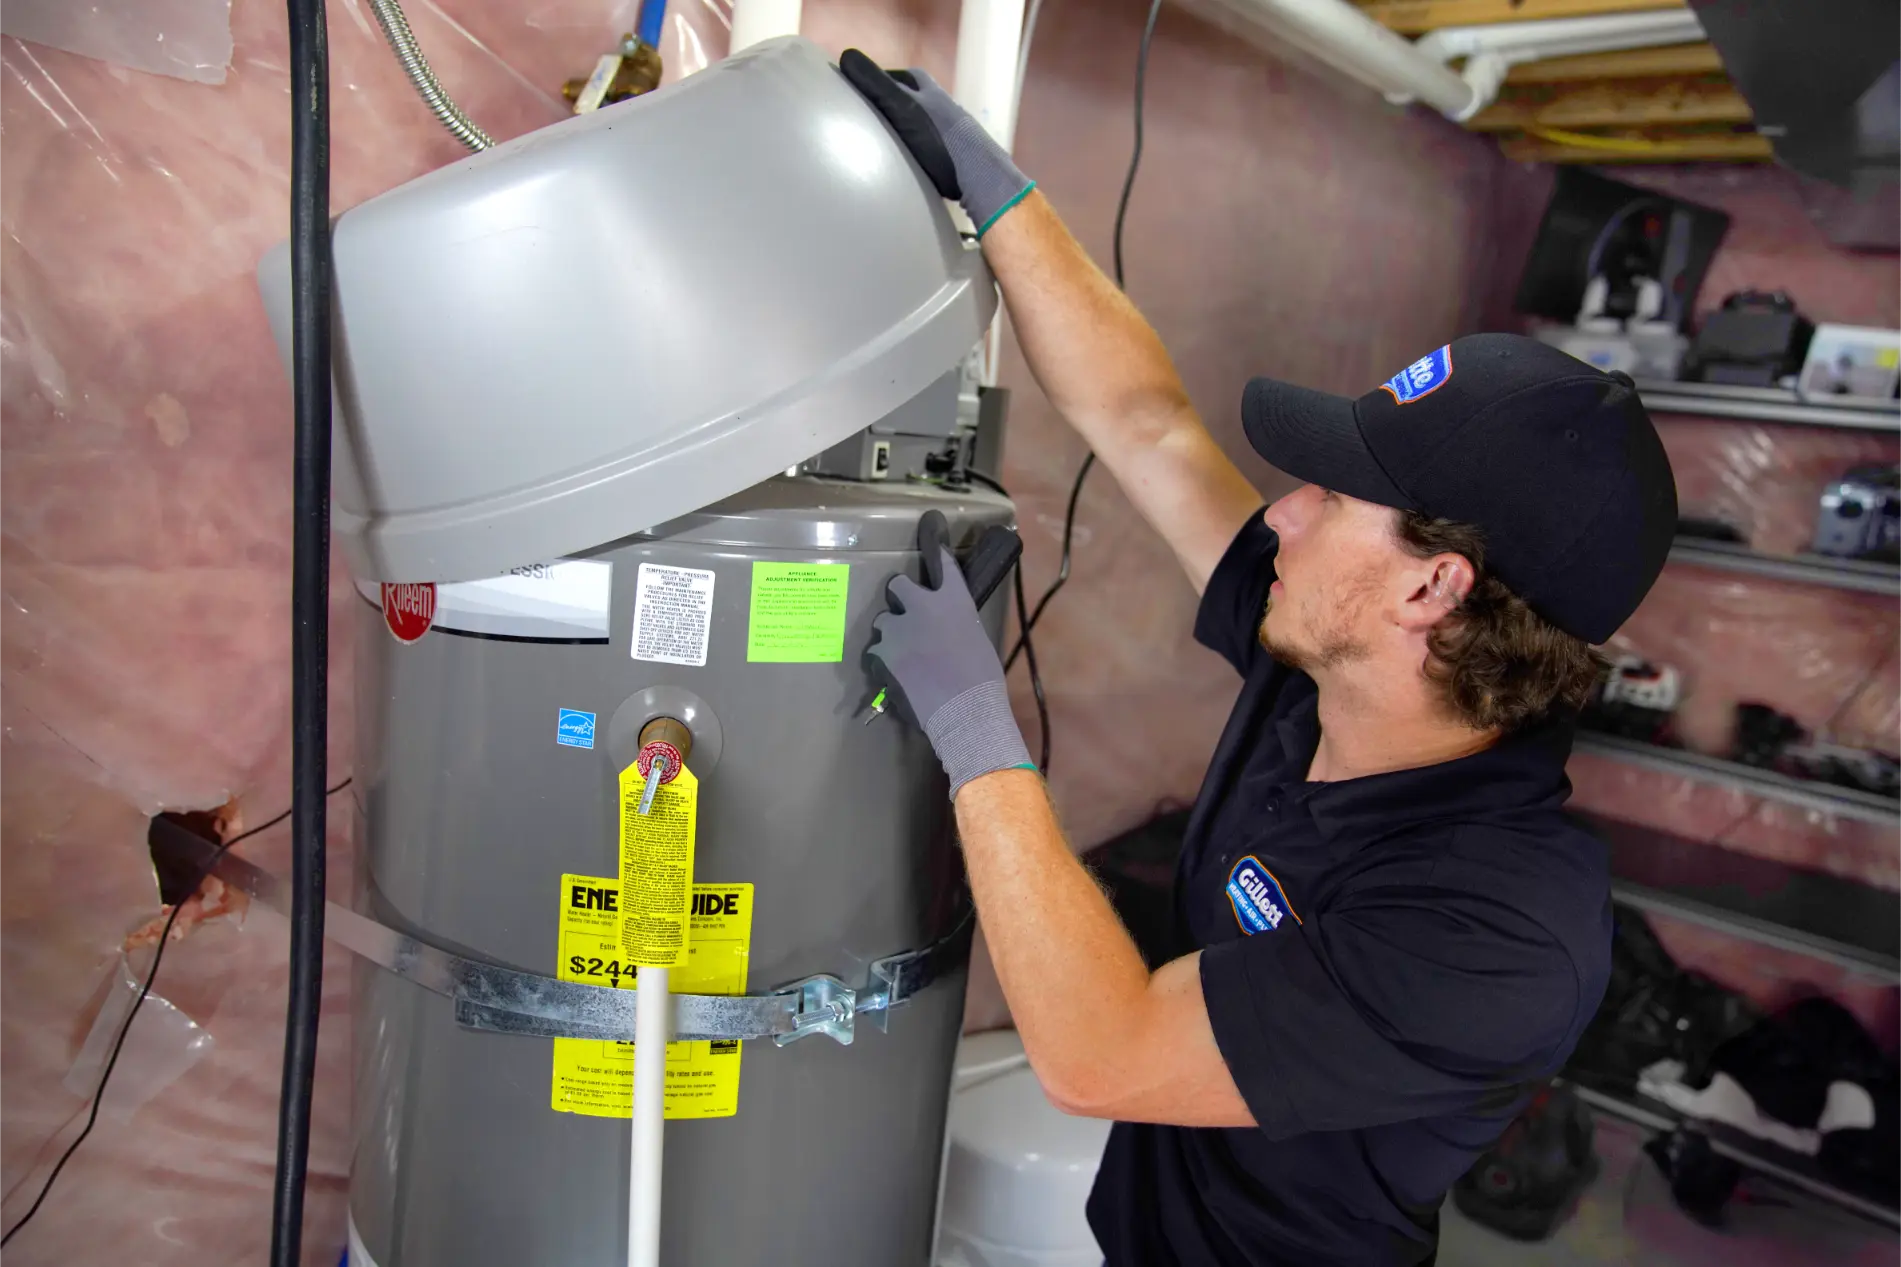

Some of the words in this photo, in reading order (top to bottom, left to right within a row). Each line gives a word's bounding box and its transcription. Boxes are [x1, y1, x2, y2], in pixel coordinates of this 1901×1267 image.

[385, 583, 432, 625] Rheem
[572, 886, 618, 912] ENE
[691, 894, 739, 915] UIDE
[569, 956, 638, 979] $244
